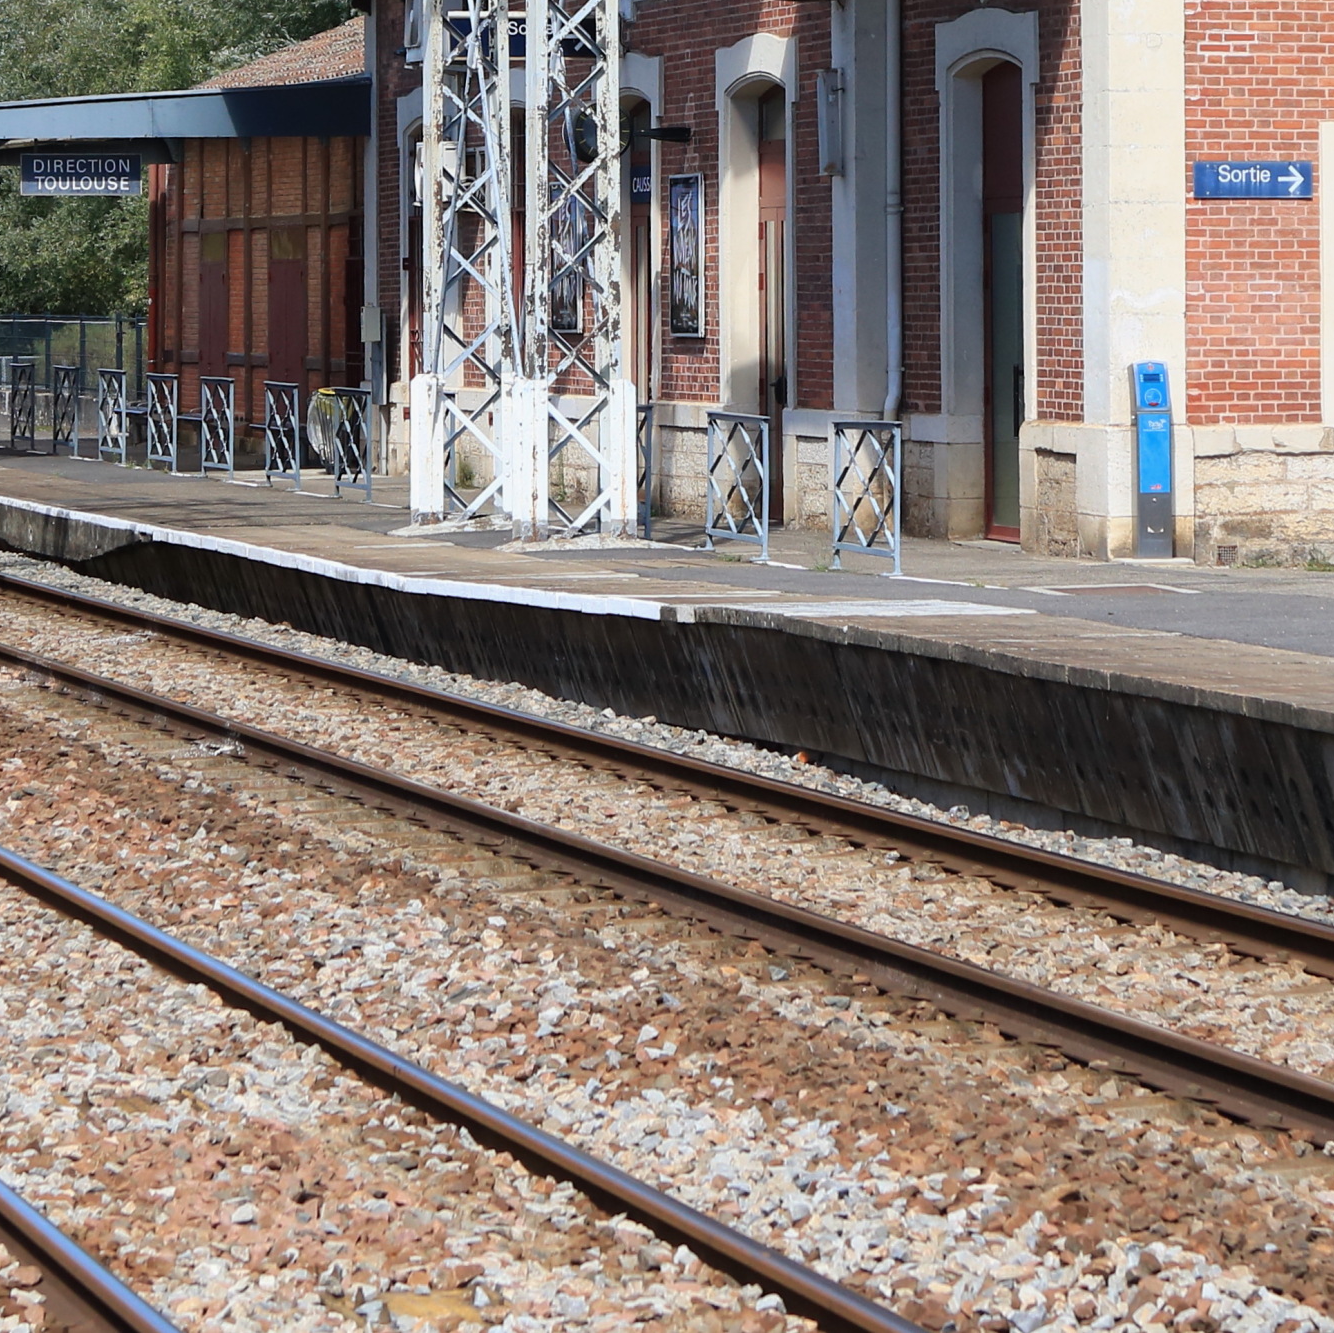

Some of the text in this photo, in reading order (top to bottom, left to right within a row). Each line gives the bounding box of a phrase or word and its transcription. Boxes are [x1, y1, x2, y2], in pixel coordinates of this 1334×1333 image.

[508, 20, 553, 36] Soe
[33, 159, 130, 173] DIRECTION
[1218, 164, 1271, 183] Sortie
[35, 176, 130, 191] TOULOUSE
[632, 176, 652, 193] CAUSS
